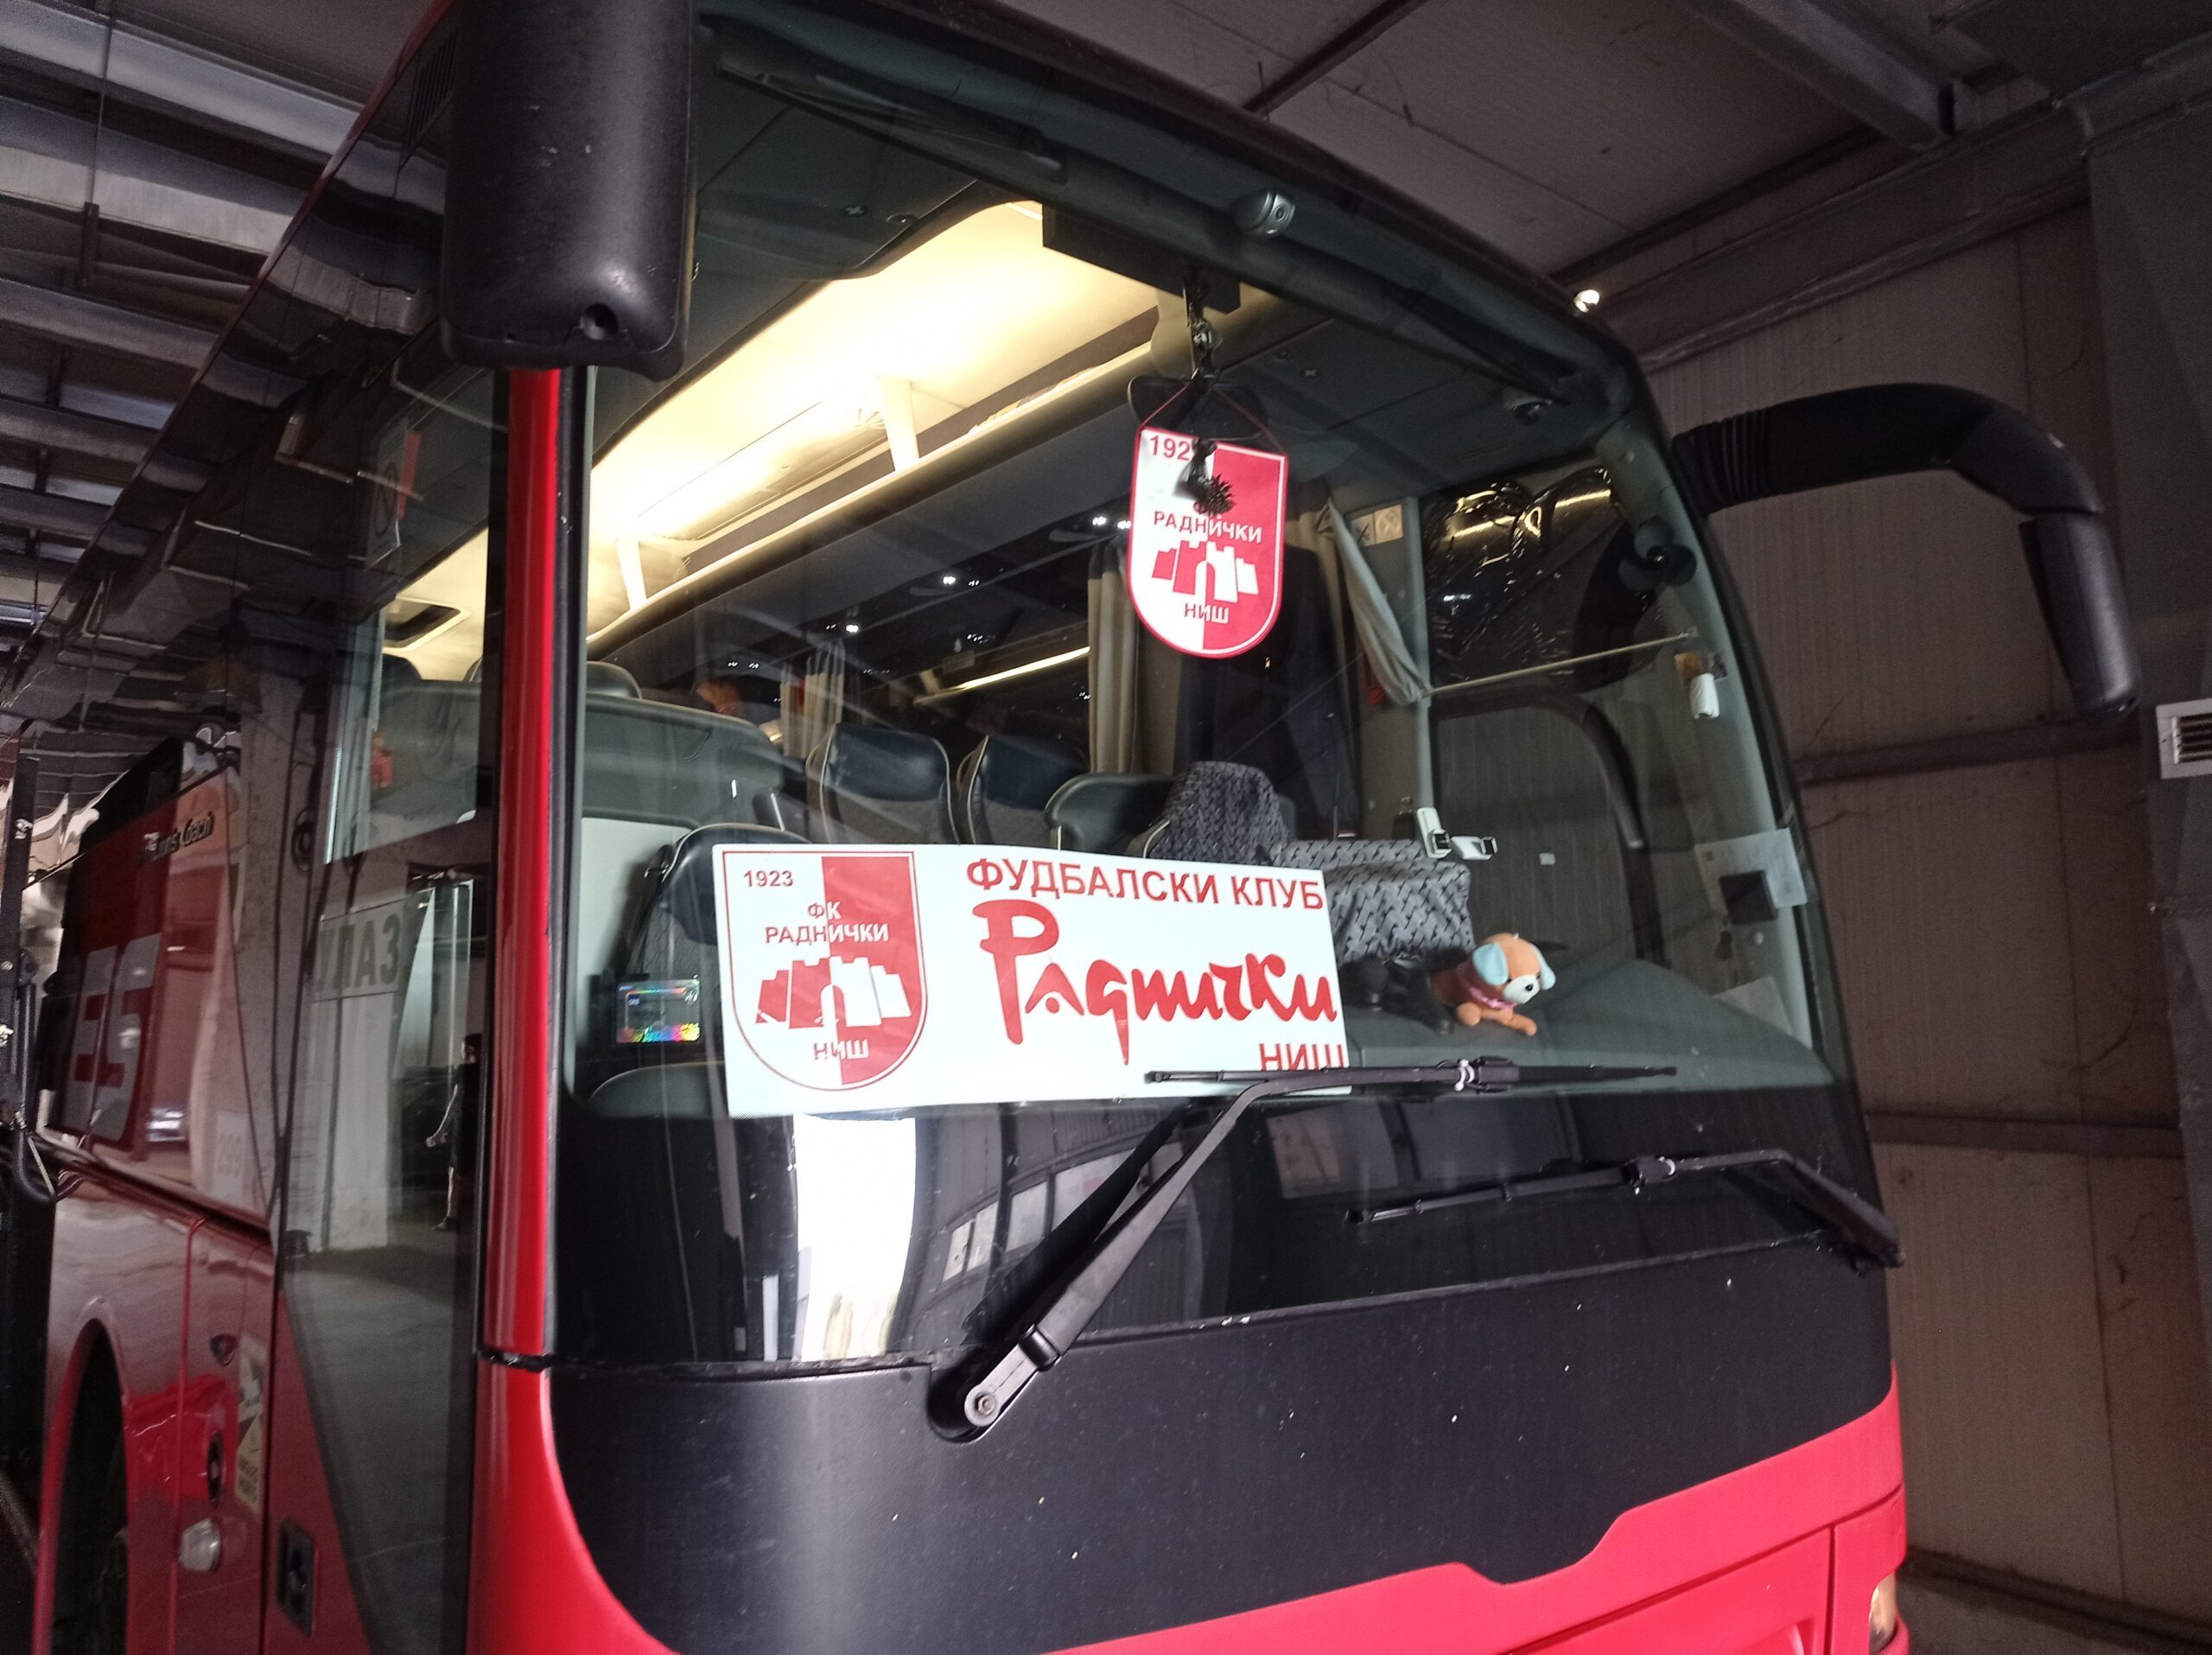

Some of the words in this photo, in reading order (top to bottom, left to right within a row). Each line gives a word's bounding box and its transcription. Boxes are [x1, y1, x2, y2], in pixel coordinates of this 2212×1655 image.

[1149, 435, 1192, 461] 192
[1154, 511, 1262, 544] РАДНИЧКИ
[1184, 602, 1229, 624] НИШ
[743, 869, 794, 888] 1923
[967, 858, 1219, 905] ФУДБАЛСКИ
[1230, 875, 1325, 909] КЛУБ
[807, 901, 842, 920] ФК
[765, 923, 889, 945] РАДНИЧКИ
[813, 1039, 869, 1060] НИШ
[1259, 1042, 1344, 1071] НИШ
